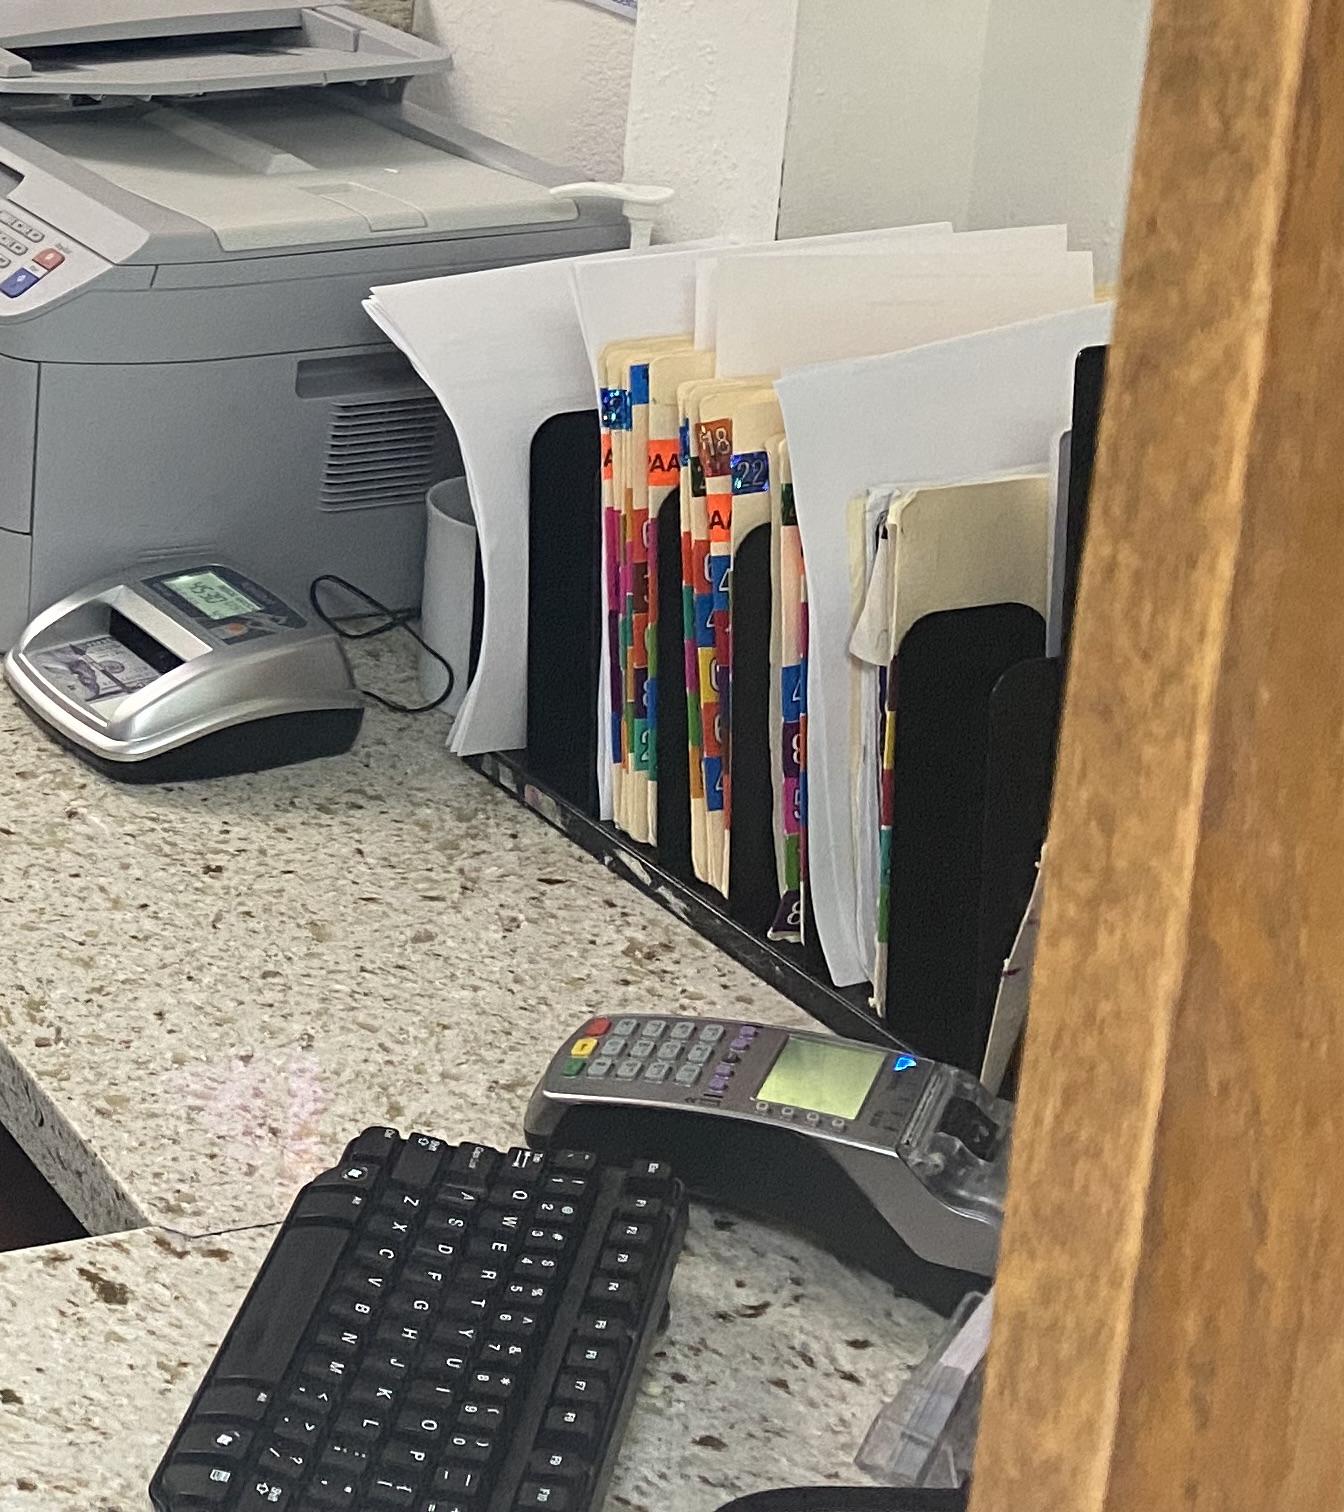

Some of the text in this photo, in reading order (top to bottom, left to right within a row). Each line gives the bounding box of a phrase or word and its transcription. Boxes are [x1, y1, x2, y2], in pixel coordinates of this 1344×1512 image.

[736, 459, 768, 488] 22
[461, 1191, 475, 1201] A
[512, 1189, 528, 1200] Q
[403, 1195, 419, 1207] Z
[541, 1203, 554, 1211] 2
[392, 1221, 407, 1232] X
[448, 1218, 464, 1227] S
[502, 1215, 518, 1228] W
[531, 1229, 544, 1238] 3
[438, 1244, 453, 1255] D
[492, 1241, 508, 1252] E
[379, 1248, 395, 1259] C
[521, 1256, 533, 1264] 4
[427, 1271, 442, 1282] F
[480, 1269, 497, 1280] R
[368, 1277, 383, 1288] V
[510, 1284, 523, 1293] 5
[355, 1303, 371, 1314] B
[413, 1300, 429, 1311] G
[471, 1299, 486, 1308] T
[499, 1313, 512, 1321] 6
[341, 1332, 358, 1345] N
[401, 1327, 418, 1340] H
[458, 1329, 474, 1339] Y
[488, 1343, 501, 1351] 7
[329, 1361, 345, 1375] M
[390, 1358, 405, 1368] J
[446, 1357, 463, 1369] U
[476, 1374, 490, 1382] 8
[574, 1380, 587, 1391] F7
[376, 1387, 393, 1400] K
[464, 1404, 478, 1413] 9
[363, 1419, 380, 1427] L
[410, 1450, 426, 1462] P
